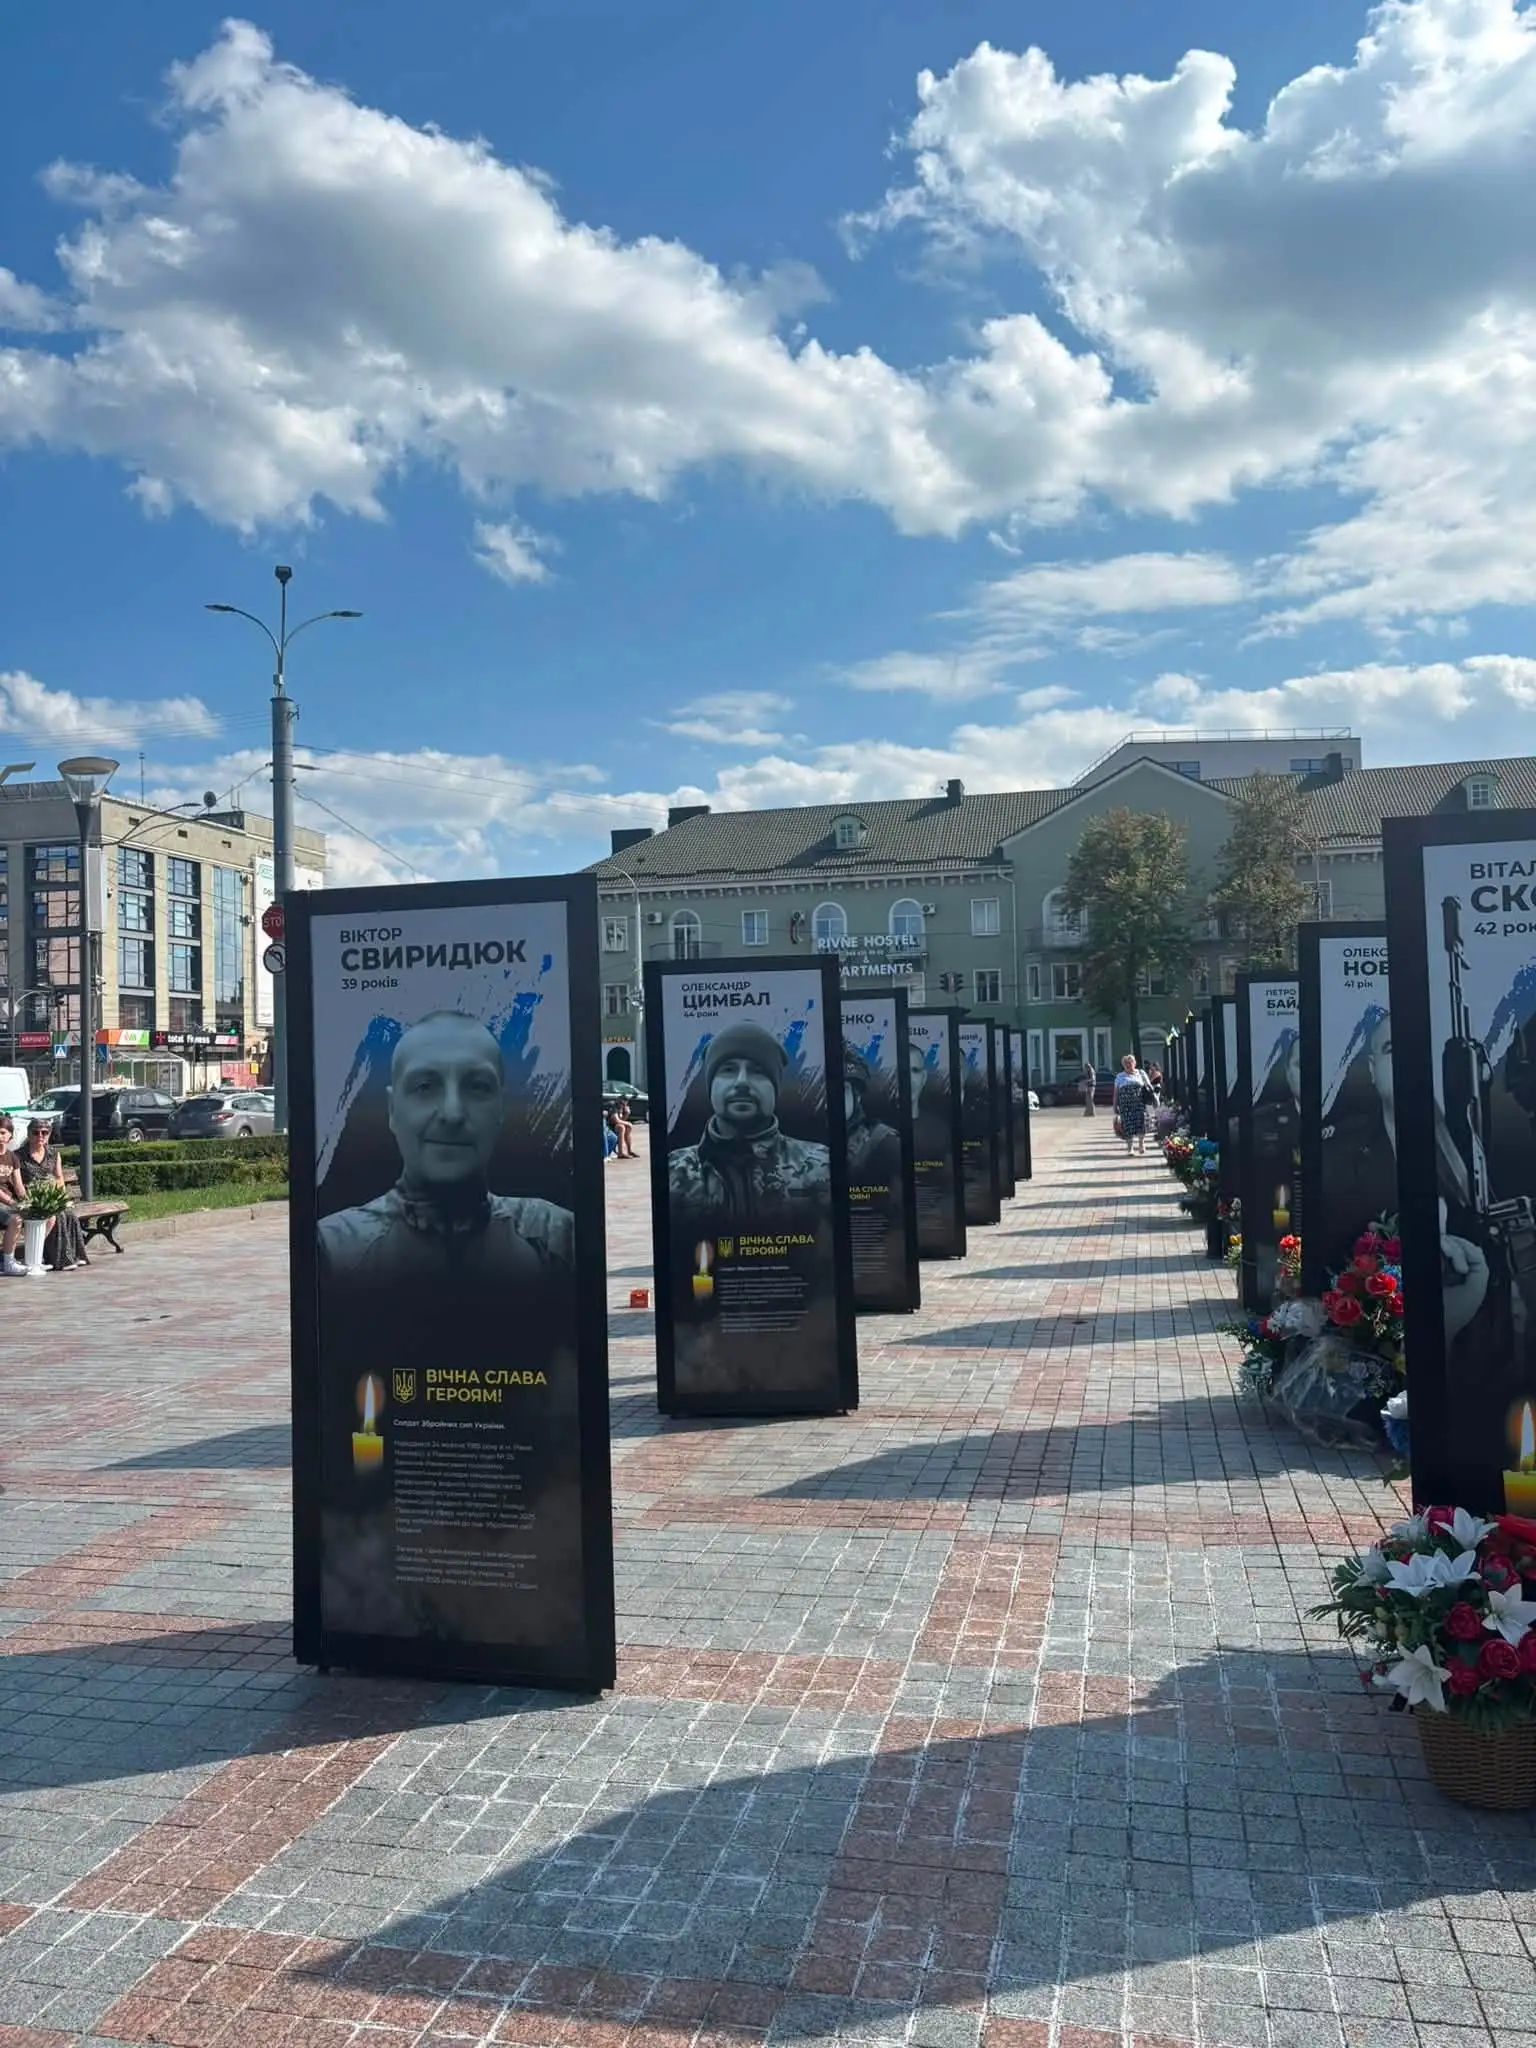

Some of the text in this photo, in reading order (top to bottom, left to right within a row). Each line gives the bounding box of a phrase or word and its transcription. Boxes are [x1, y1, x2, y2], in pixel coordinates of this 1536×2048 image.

[264, 917, 285, 928] STO
[1474, 921, 1498, 935] 42
[340, 927, 402, 943] ВІКТОР
[818, 934, 917, 949] RIVNE HOSTEL
[341, 939, 527, 972] СВИРИДЮК
[839, 963, 913, 977] ARTMENTS
[341, 976, 399, 991] 39 років
[681, 981, 751, 992] ОЛЕКСАНДР
[1358, 979, 1373, 989] рік
[683, 992, 770, 1009] ЦИМБАЛ
[1267, 996, 1300, 1009] БАЙ
[739, 1234, 815, 1246] ВІЧНА СЛАВА
[739, 1246, 787, 1256] ГЕРОЯМ!
[426, 1369, 547, 1385] ВІЧНА СЛАВА
[426, 1387, 503, 1402] ГЕРОЯМ!
